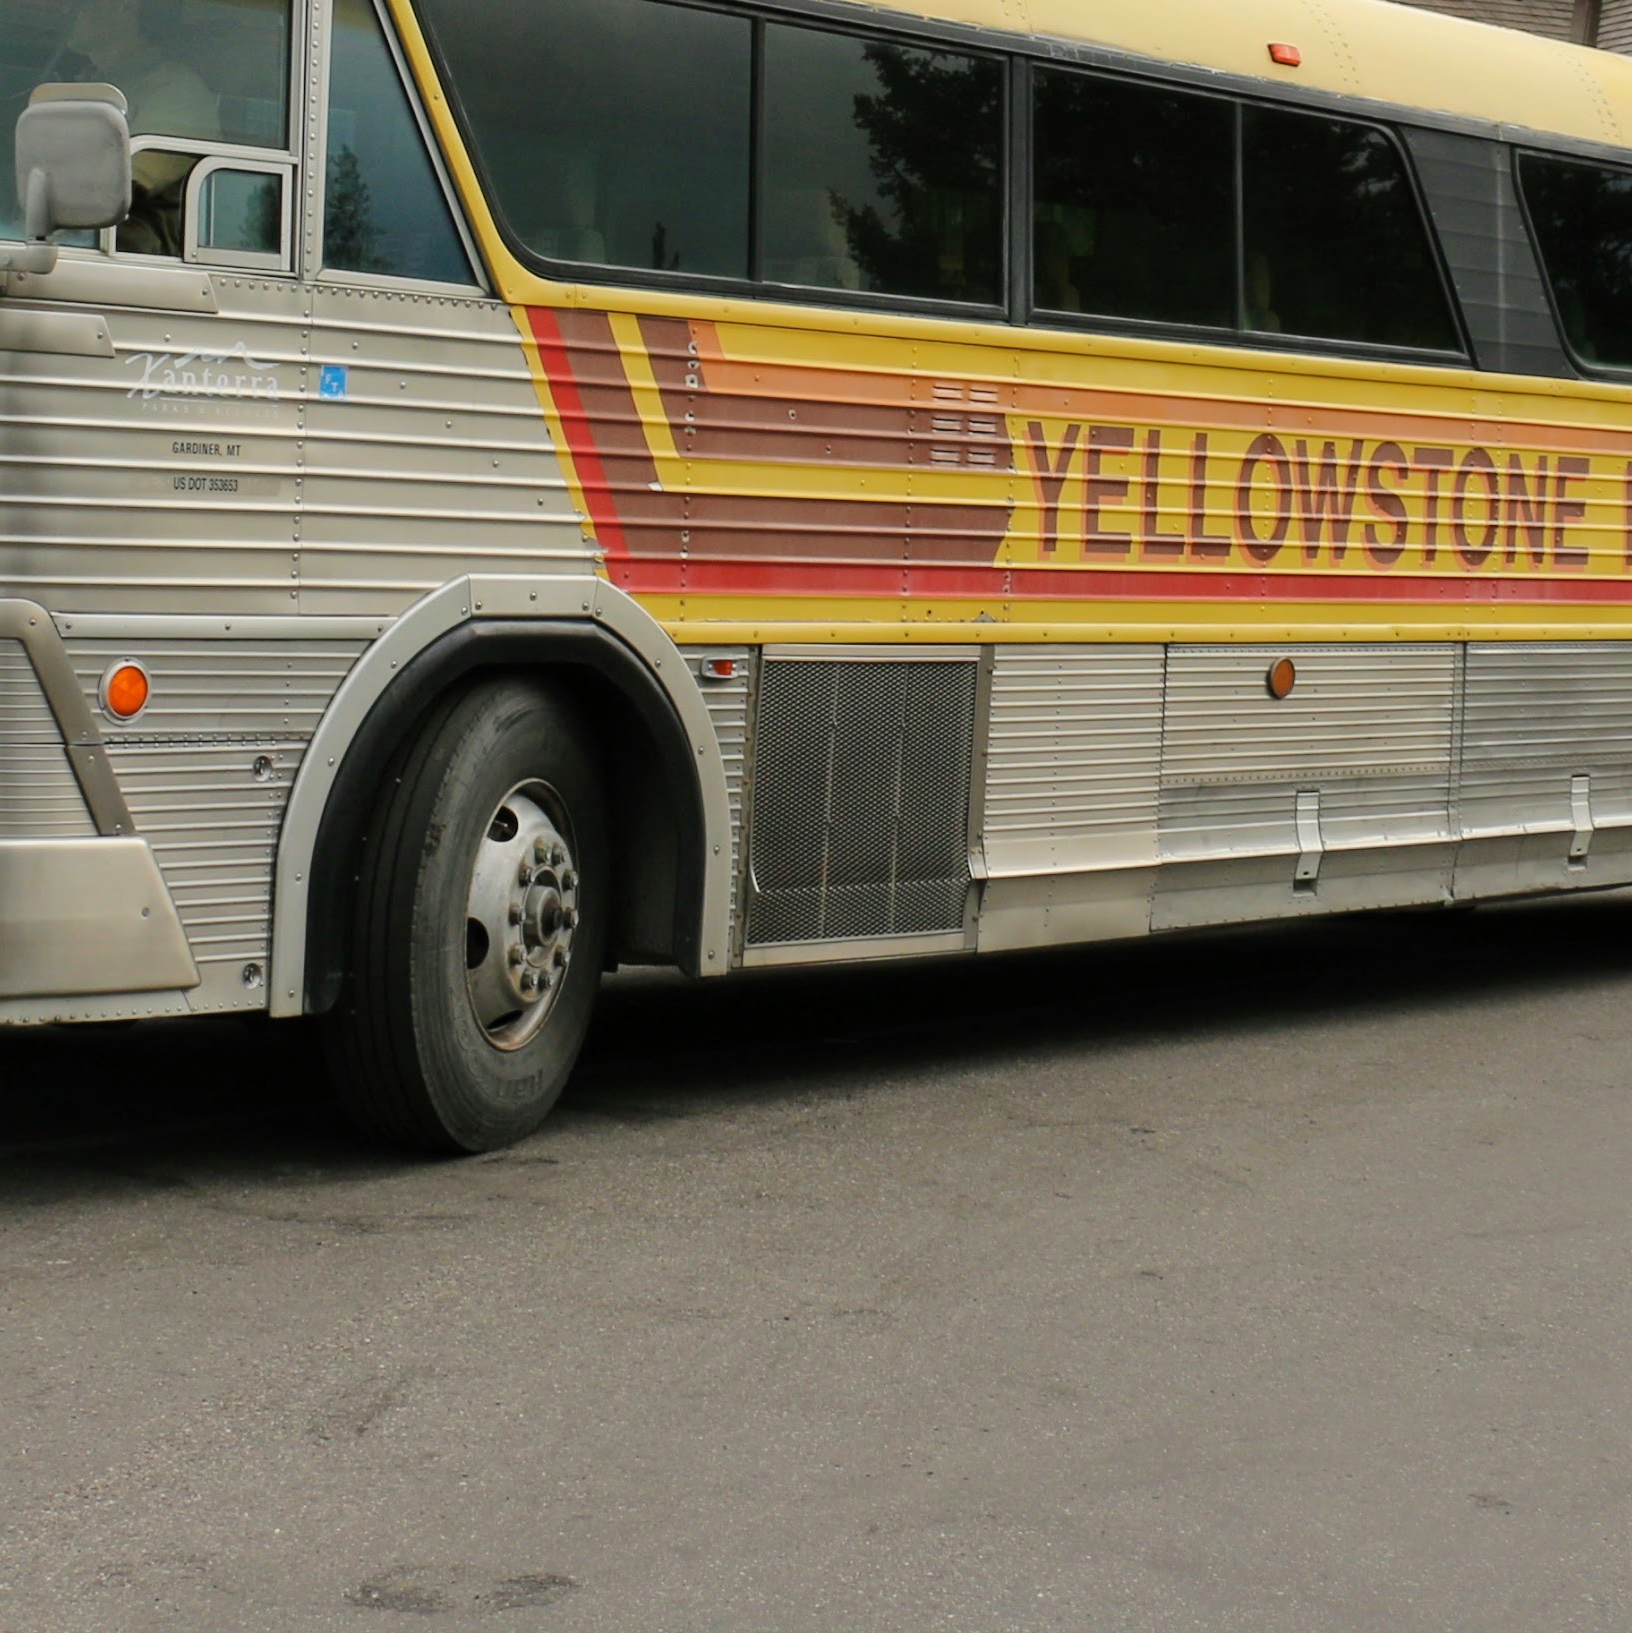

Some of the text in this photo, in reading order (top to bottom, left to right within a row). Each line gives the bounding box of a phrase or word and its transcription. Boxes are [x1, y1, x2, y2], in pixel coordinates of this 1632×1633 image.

[125, 352, 279, 401] Xanterra
[172, 441, 241, 457] GARDINER, MT
[173, 477, 186, 490] US
[188, 478, 208, 490] DOT
[1023, 421, 1591, 572] YELLOWSTONE
